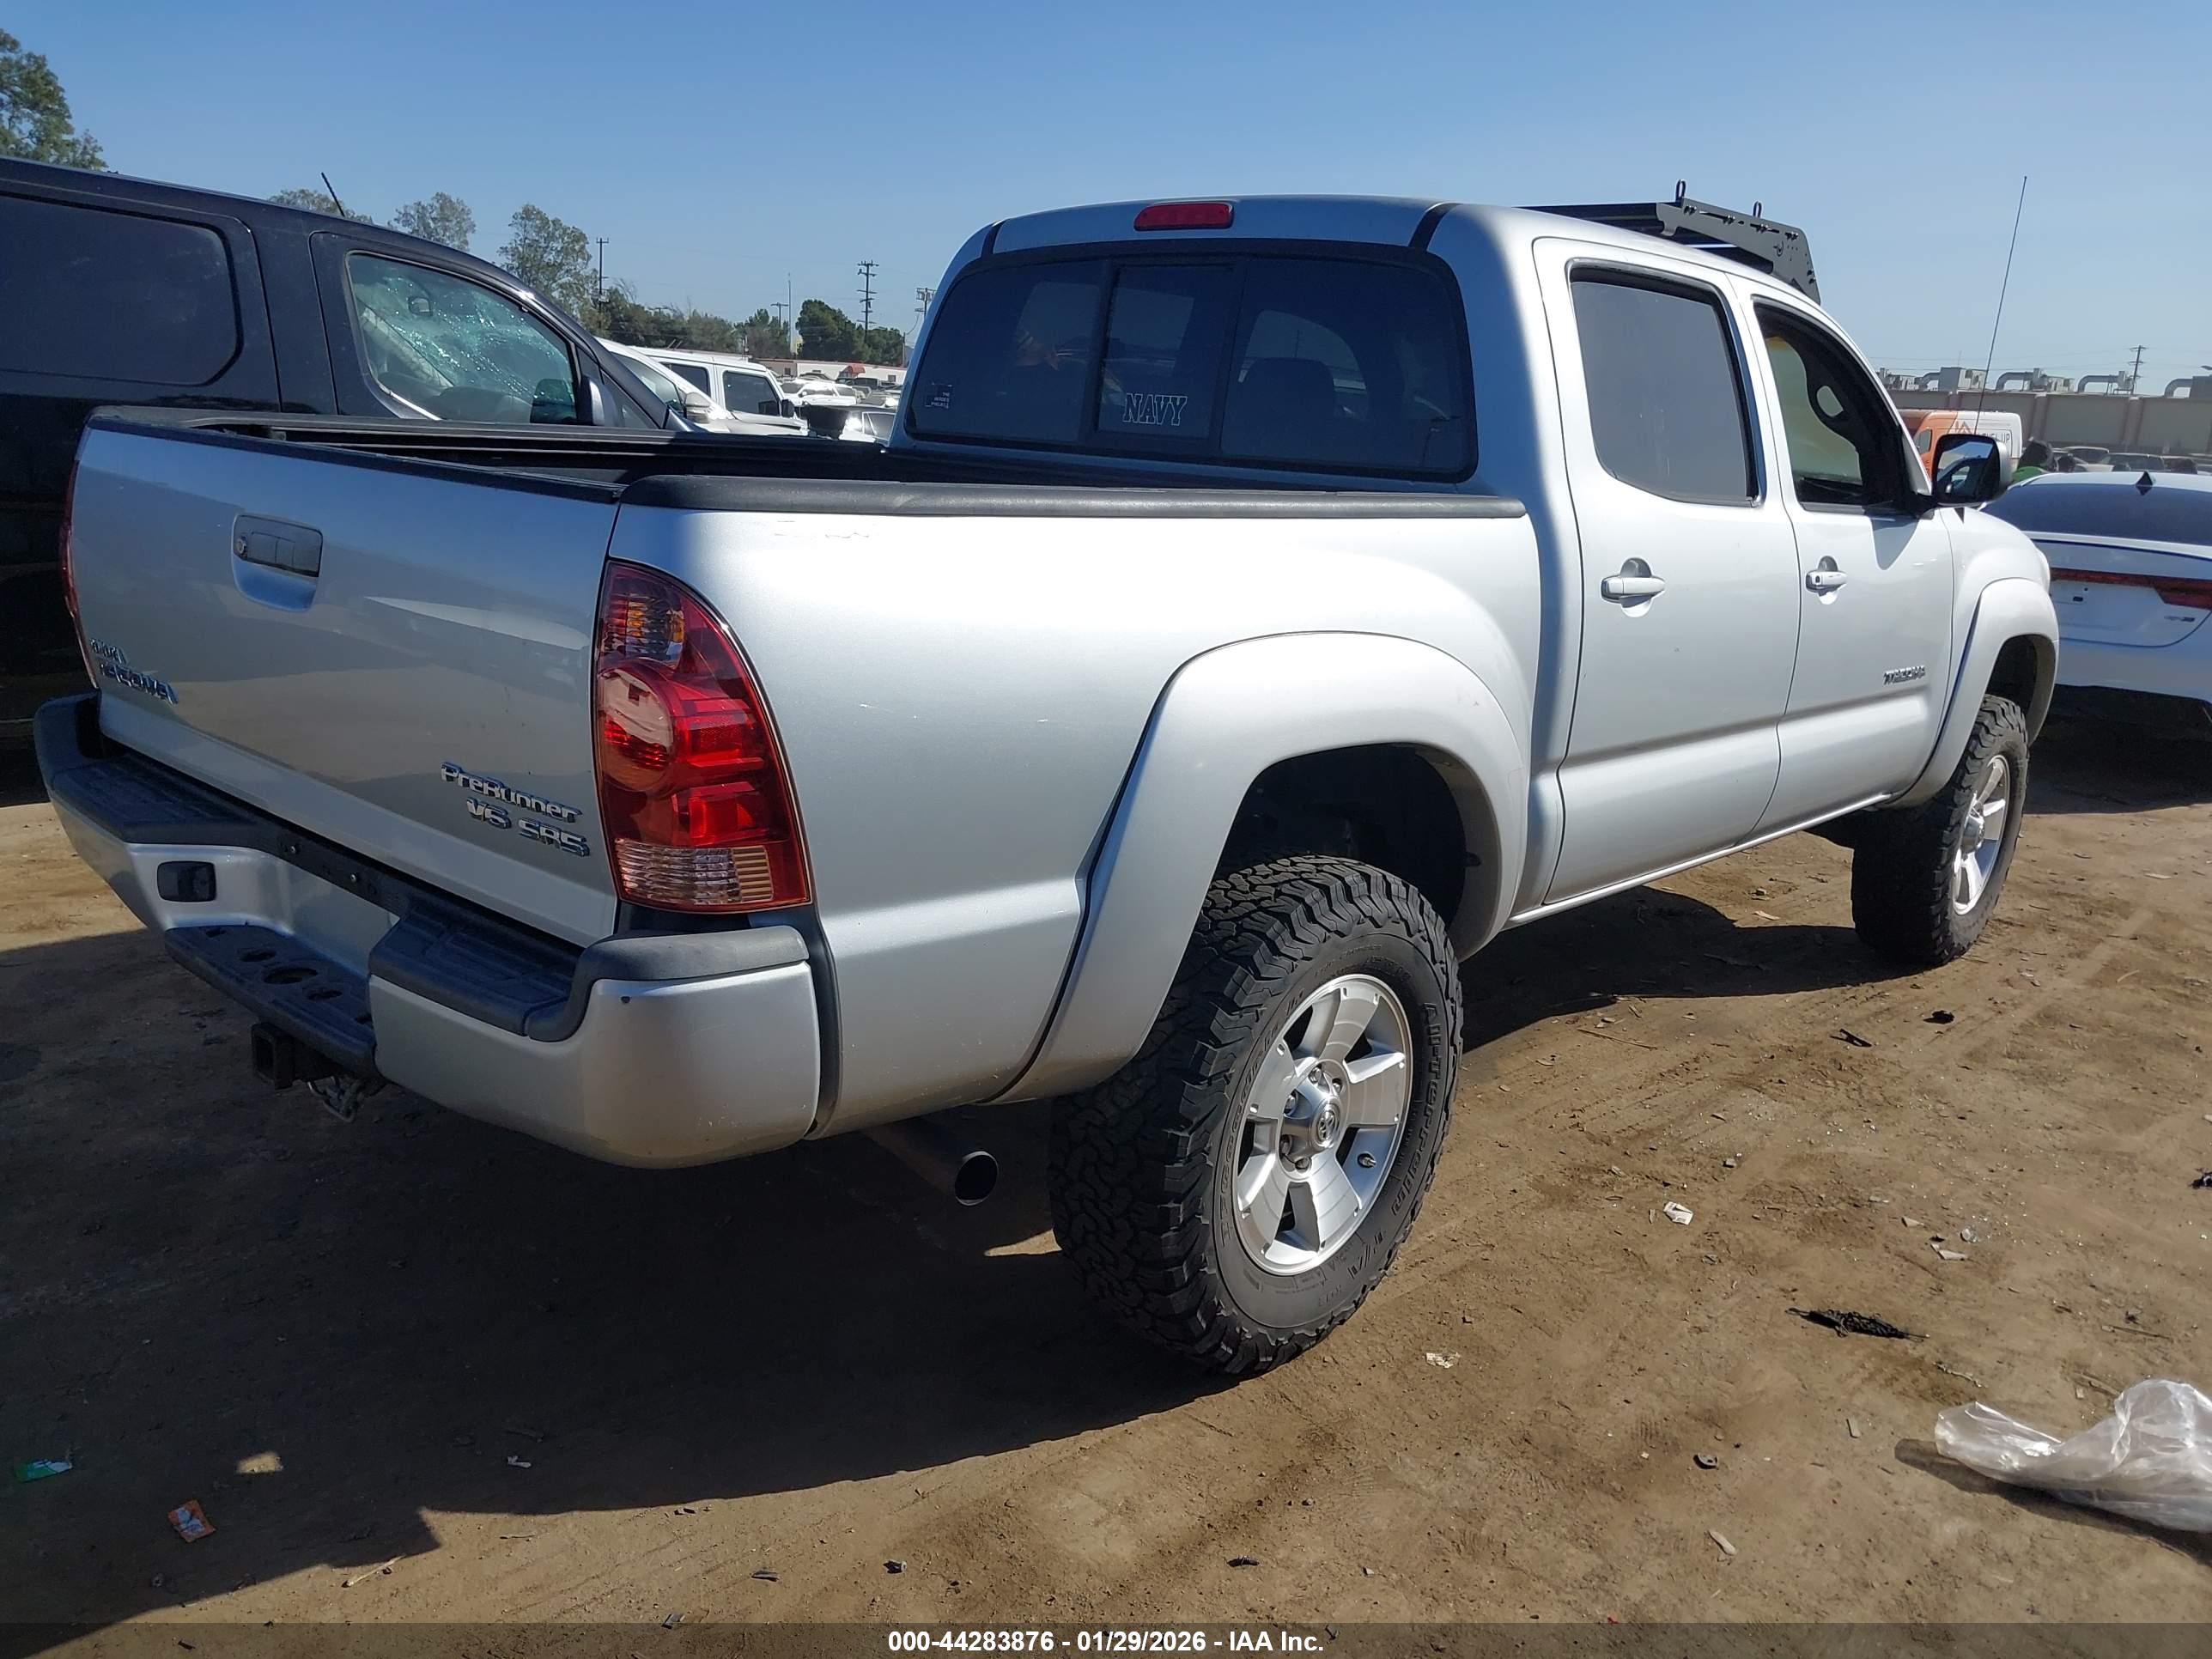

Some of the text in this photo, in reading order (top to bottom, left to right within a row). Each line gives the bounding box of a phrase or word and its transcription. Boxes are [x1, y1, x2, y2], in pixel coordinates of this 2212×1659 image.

[1122, 392, 1188, 426] NAVY
[441, 762, 582, 823] PreRunner
[466, 797, 591, 857] V6 SR5
[1391, 1002, 1442, 1217] All-Terrain
